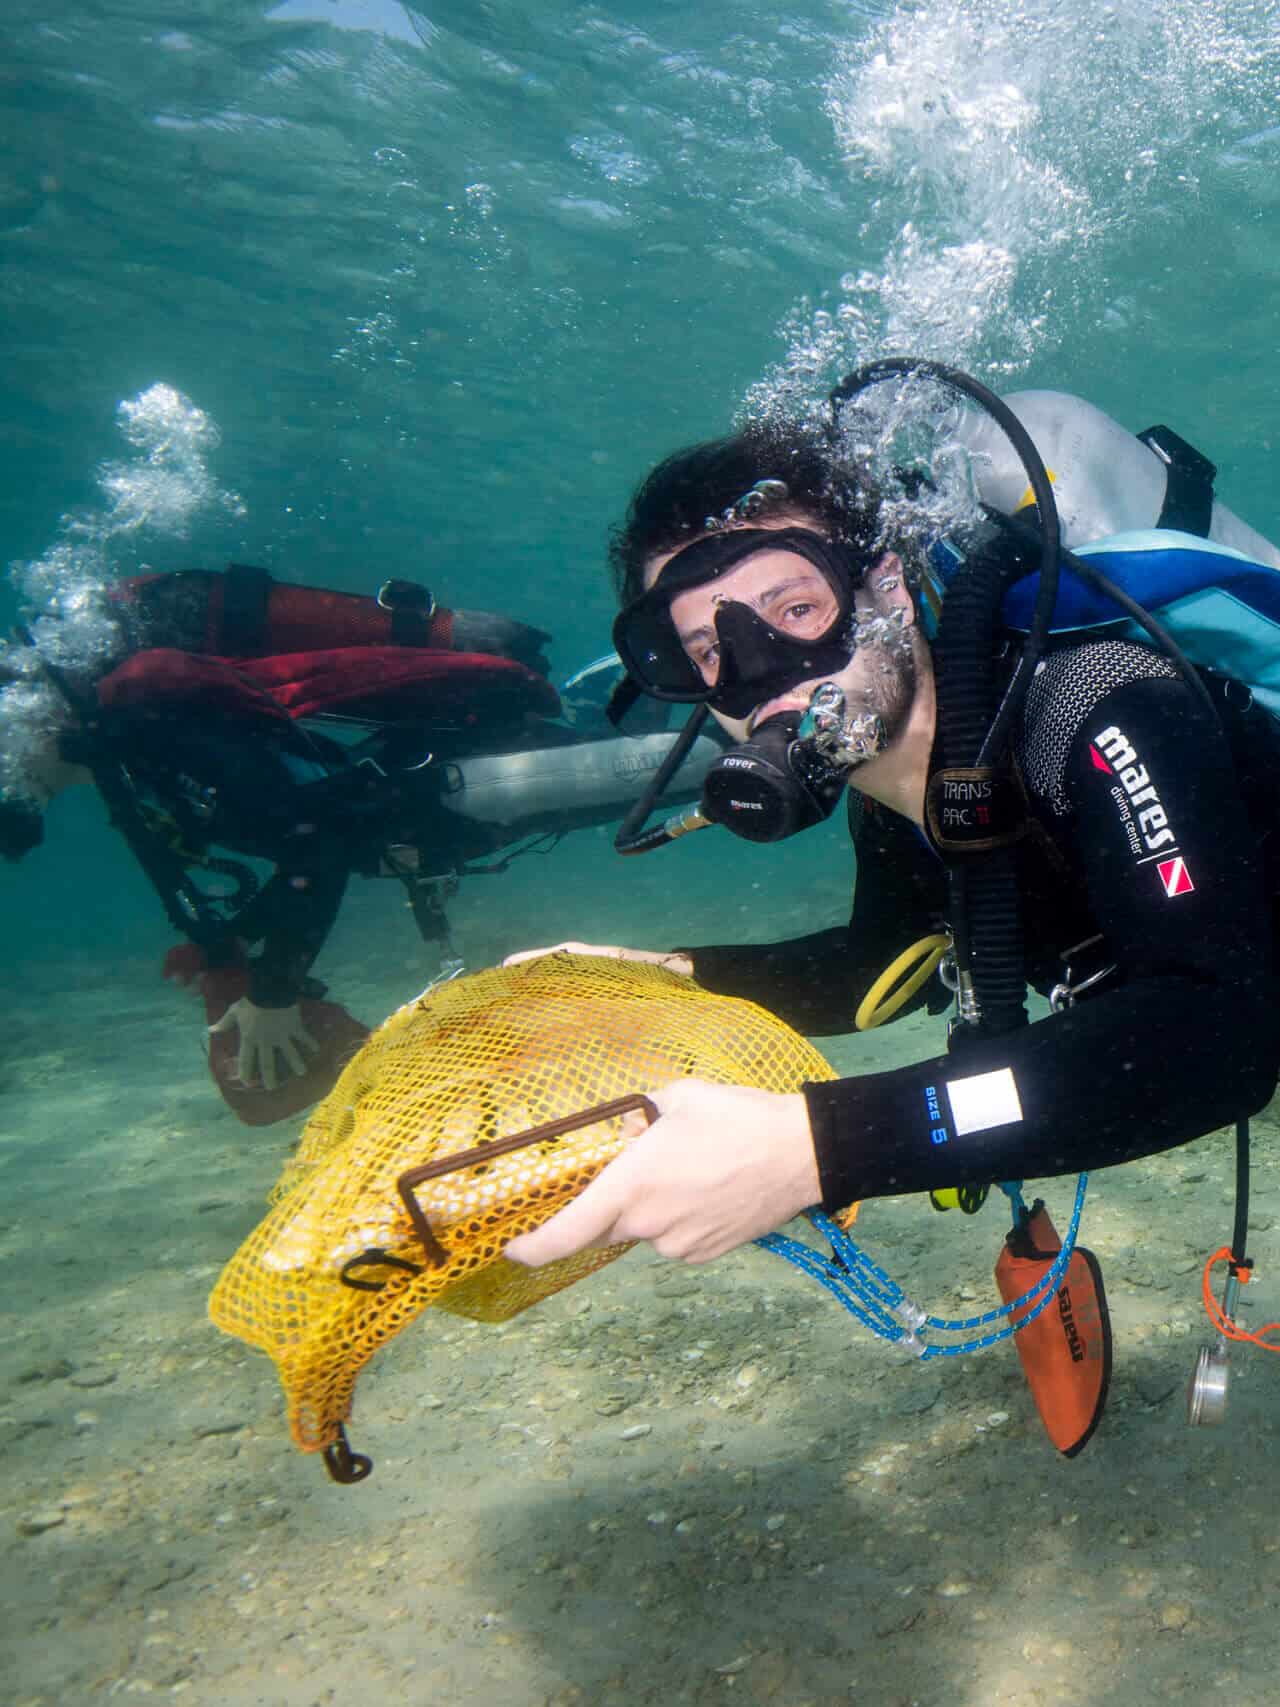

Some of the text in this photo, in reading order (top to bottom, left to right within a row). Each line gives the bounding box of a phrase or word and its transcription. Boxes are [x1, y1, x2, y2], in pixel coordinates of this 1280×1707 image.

[723, 757, 759, 769] rover
[943, 781, 992, 800] TRANS
[1094, 726, 1175, 849] mares
[1110, 785, 1143, 856] diving center
[925, 1086, 948, 1145] SIZE 5
[1057, 1285, 1084, 1362] mares
